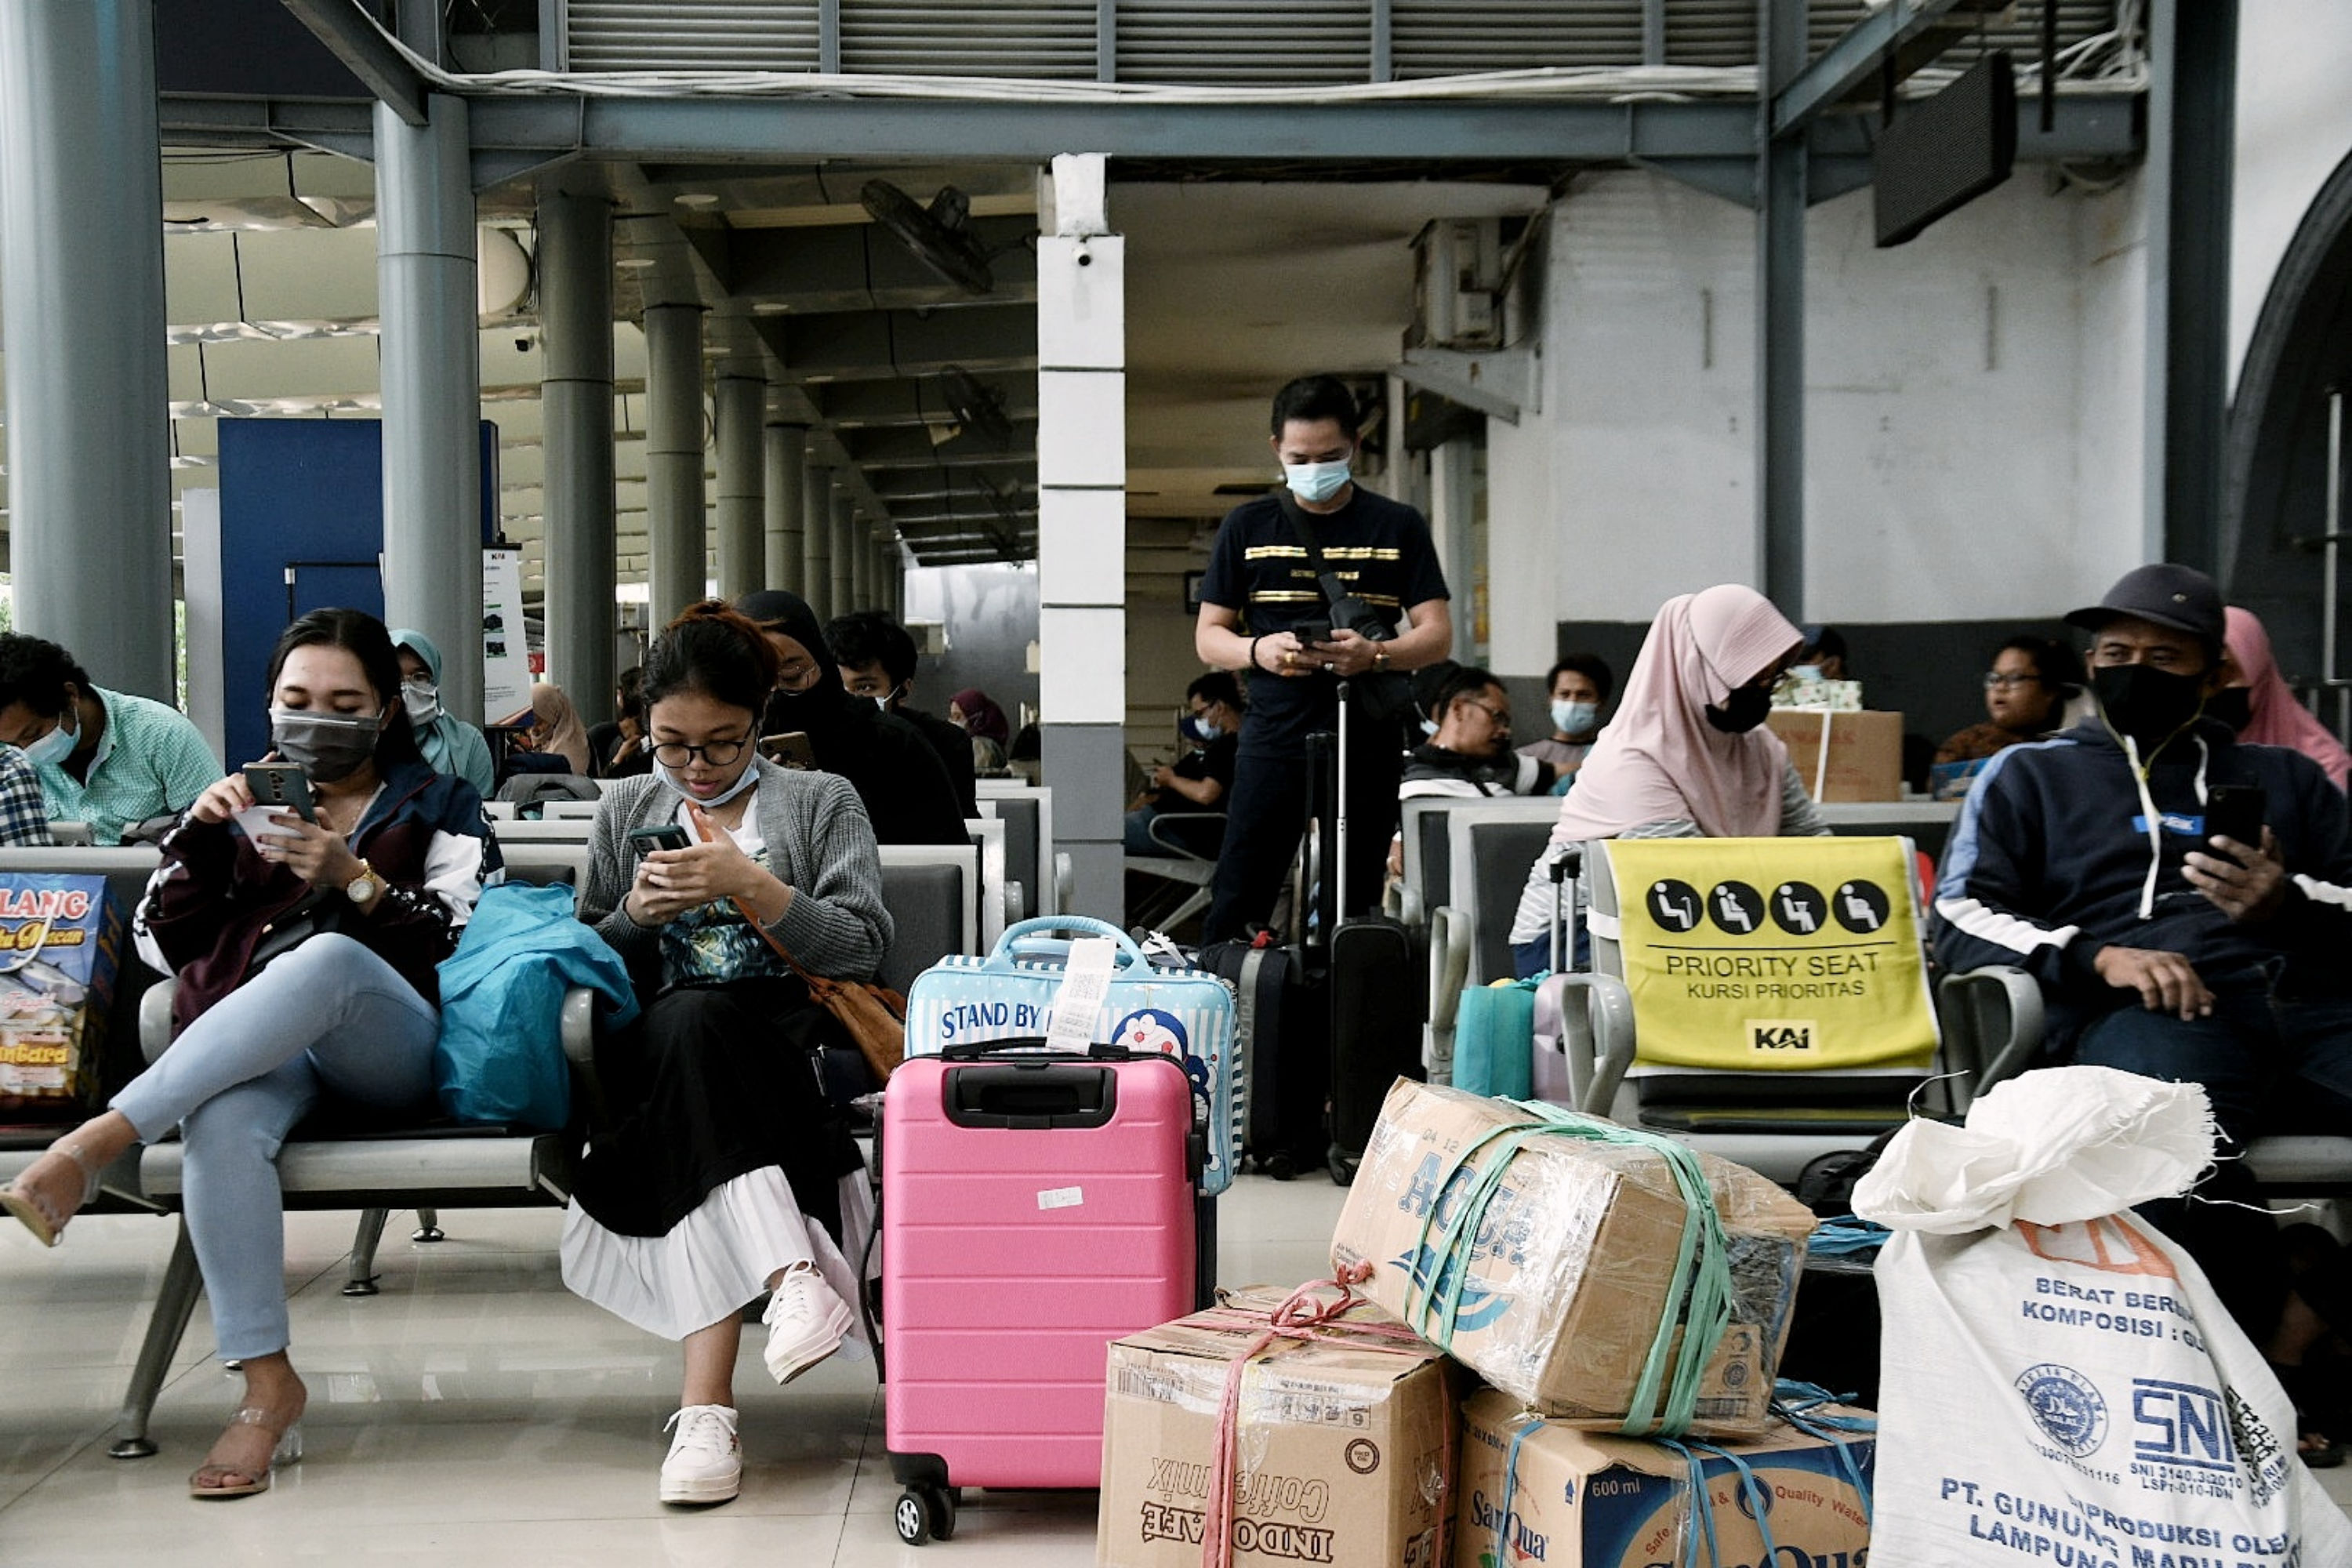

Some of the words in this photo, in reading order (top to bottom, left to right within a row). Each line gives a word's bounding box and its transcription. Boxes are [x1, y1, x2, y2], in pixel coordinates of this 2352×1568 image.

[1666, 955, 1798, 978] PRIORITY
[1808, 952, 1880, 976] SEAT
[1687, 982, 1749, 1000] KURSI
[1756, 980, 1865, 1000] PRIORITAS
[942, 1002, 1008, 1039] STAND
[1014, 1002, 1042, 1029] BY
[2036, 1277, 2114, 1305] BERAT
[2023, 1300, 2163, 1338] KOMPOSISI
[1352, 1412, 1364, 1427] 6
[2133, 1388, 2235, 1463] SNI
[2130, 1463, 2154, 1477] SNI
[1147, 1457, 1330, 1524] Coffemix
[1592, 1479, 1619, 1497] 600
[1622, 1477, 1641, 1494] ml
[1941, 1477, 1984, 1508] PT.
[1775, 1485, 1824, 1508] Quality
[1831, 1499, 1869, 1528] Water
[1141, 1501, 1334, 1563] INDOAFÉ
